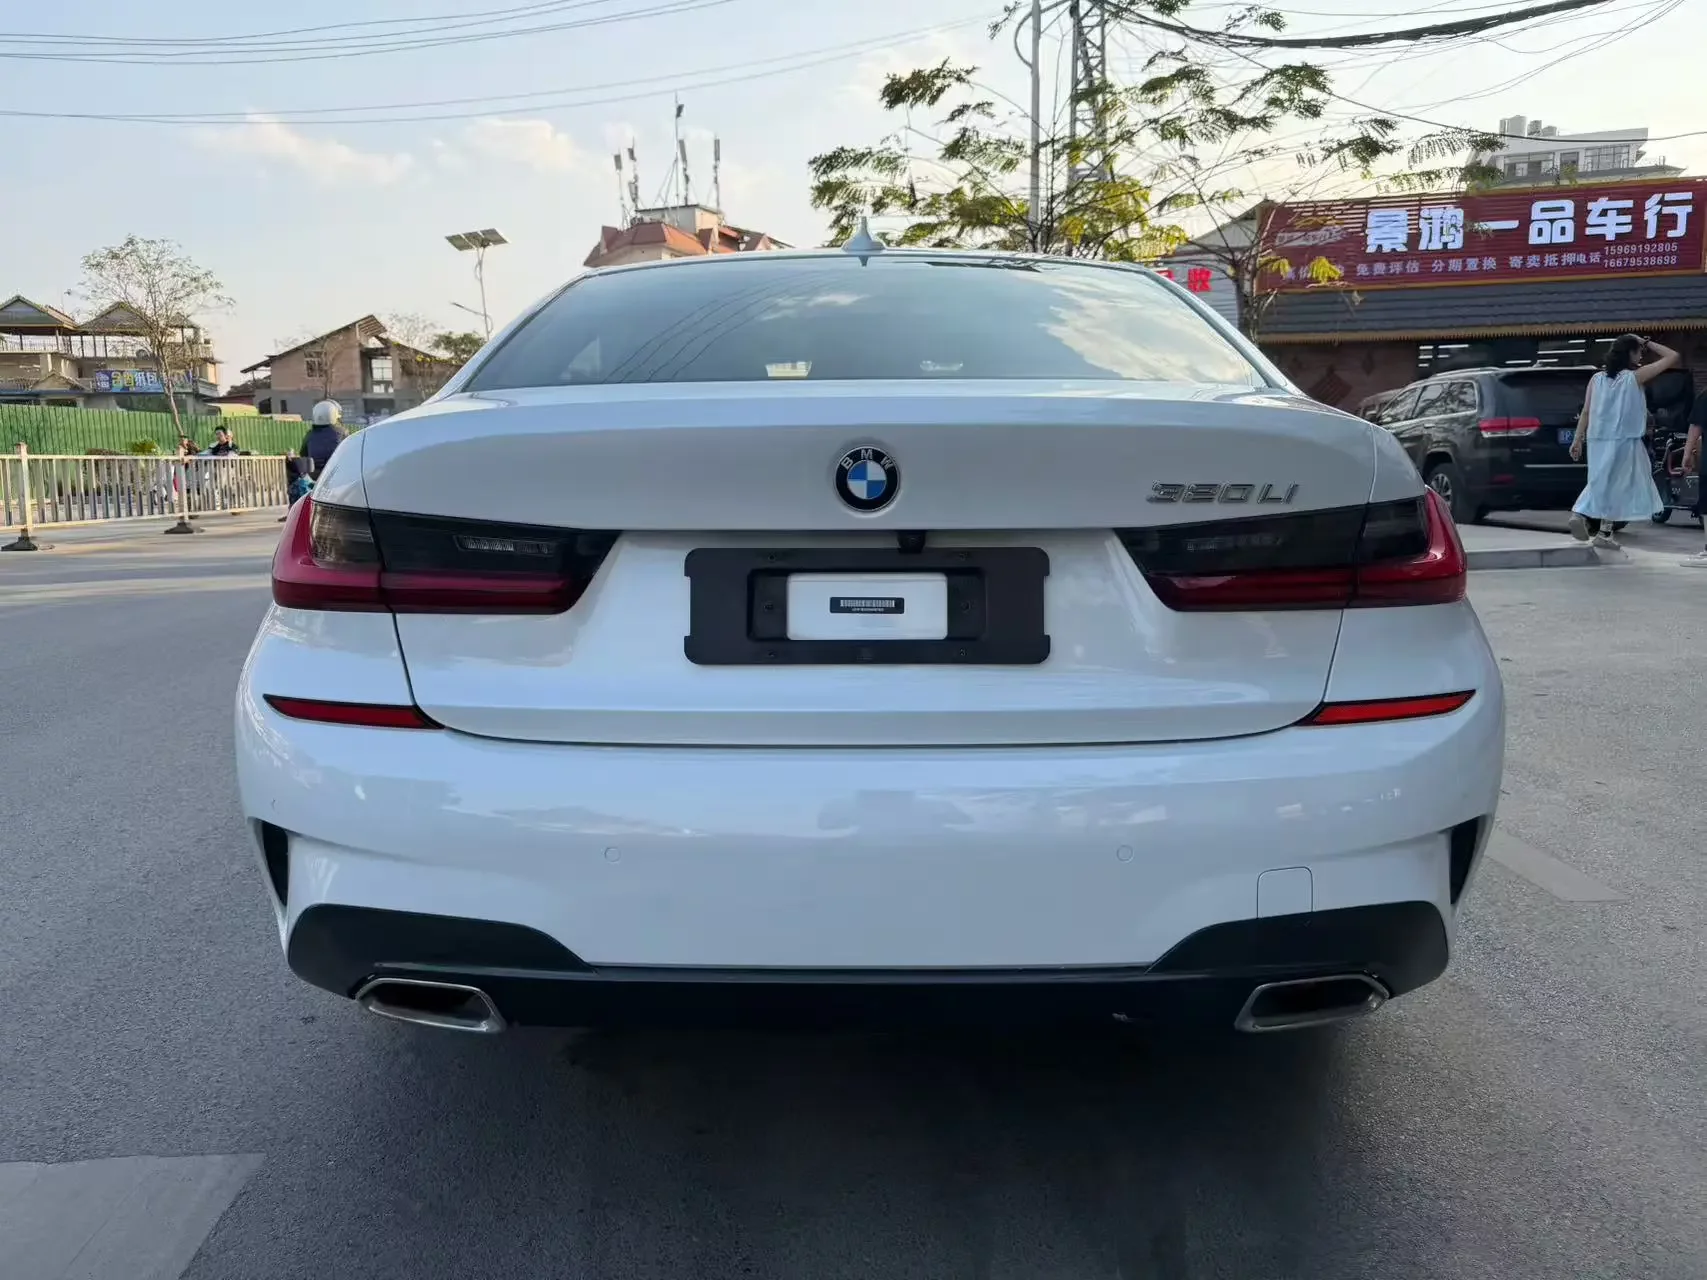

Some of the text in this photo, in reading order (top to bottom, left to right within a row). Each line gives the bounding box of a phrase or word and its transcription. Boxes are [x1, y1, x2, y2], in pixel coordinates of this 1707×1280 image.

[1603, 242, 1678, 256] 15969192805
[1431, 256, 1497, 273] 分期置换
[841, 449, 894, 471] BMW
